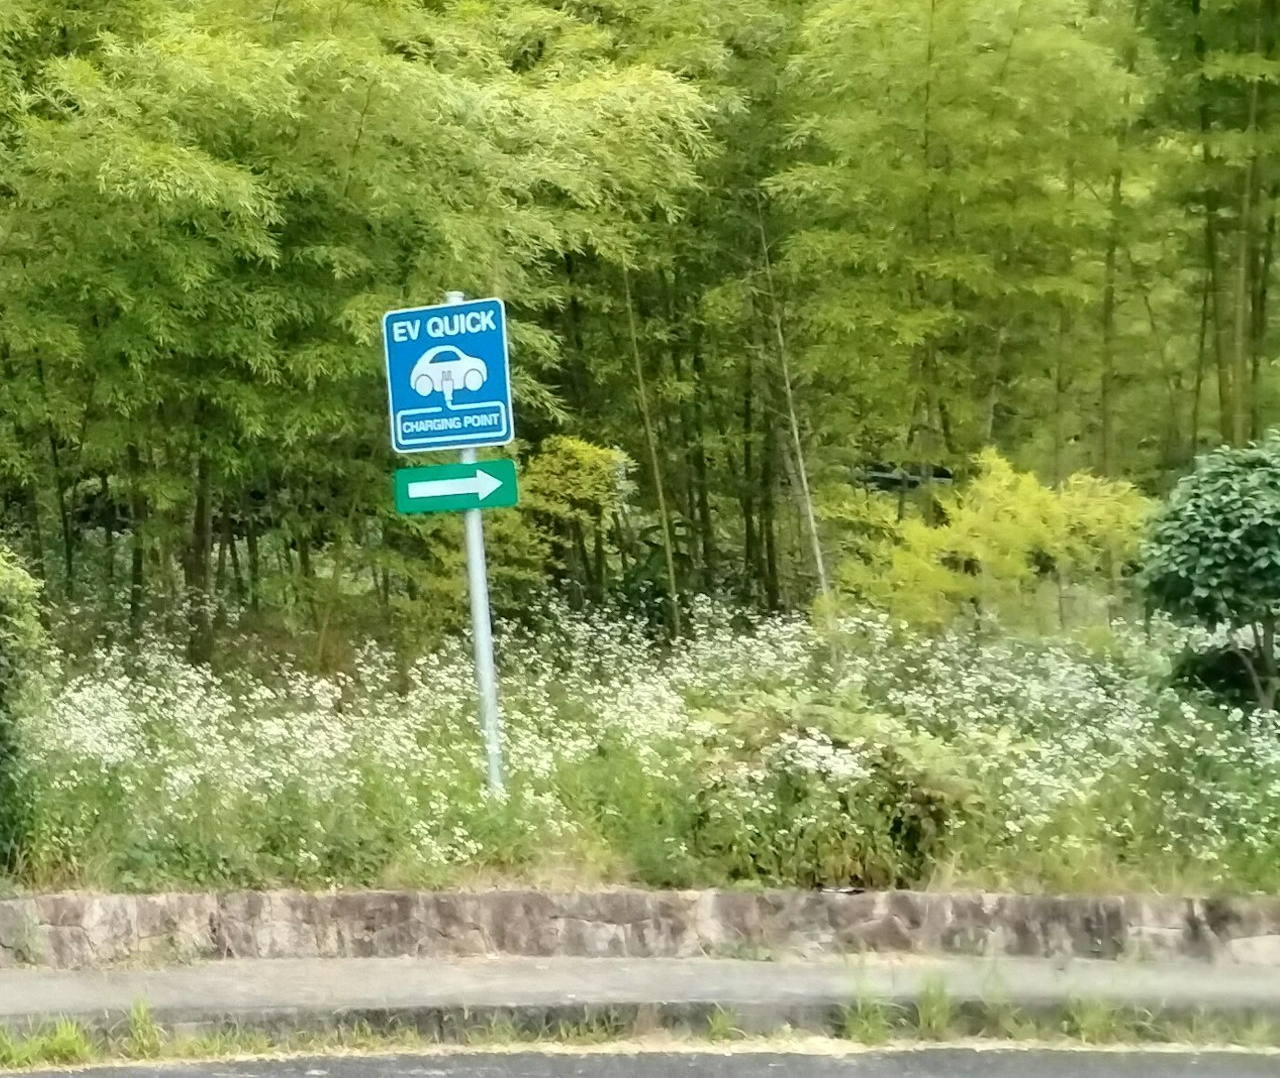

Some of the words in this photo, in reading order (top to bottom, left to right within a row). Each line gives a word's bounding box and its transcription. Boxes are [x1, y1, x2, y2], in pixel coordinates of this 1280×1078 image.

[393, 320, 420, 342] EV
[427, 310, 496, 338] QUICK
[402, 417, 461, 433] CHARGING
[463, 413, 500, 428] POINT
